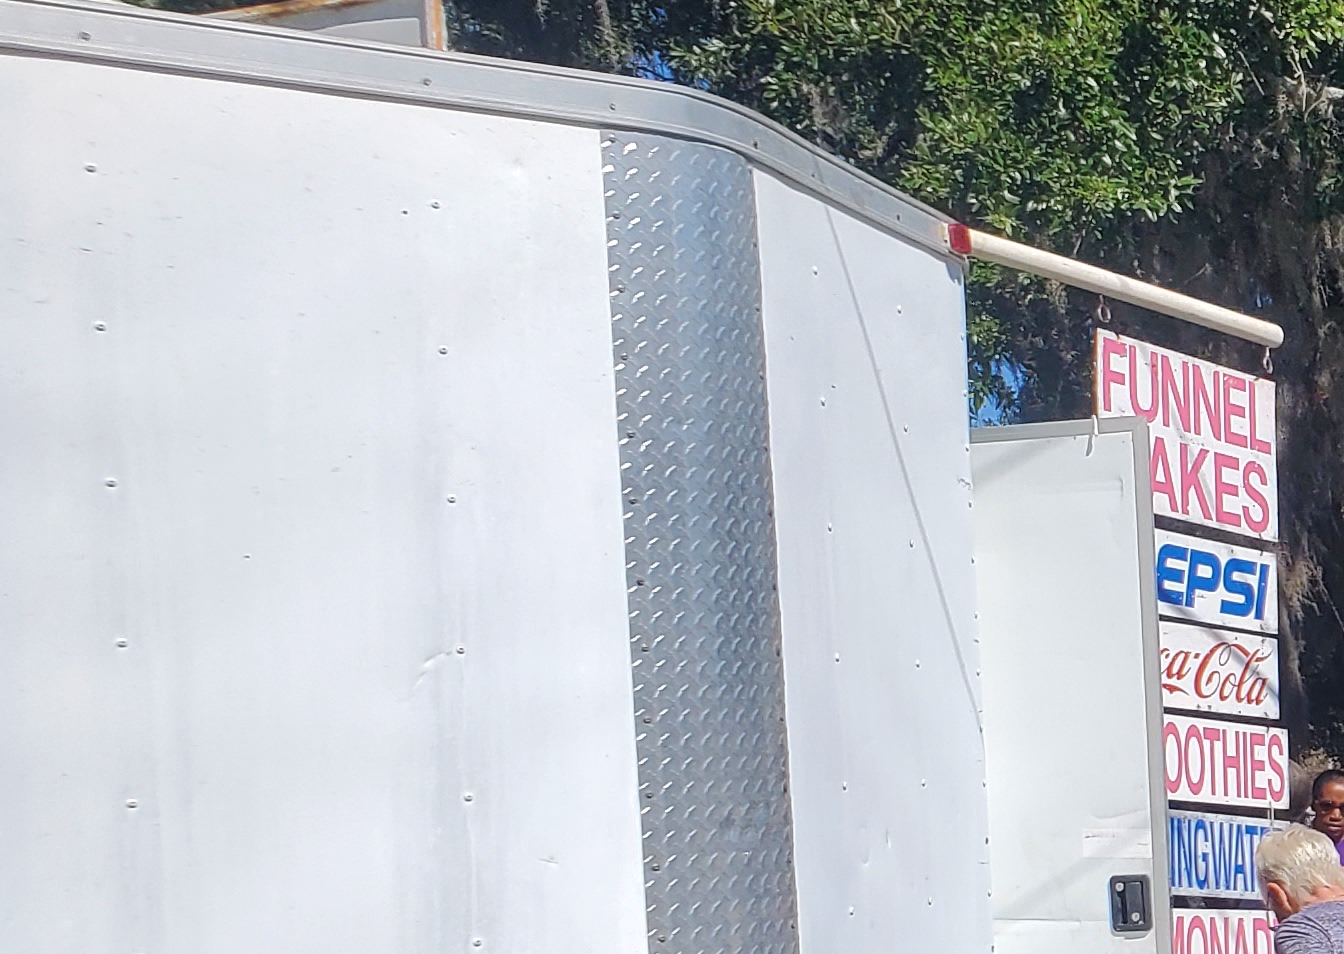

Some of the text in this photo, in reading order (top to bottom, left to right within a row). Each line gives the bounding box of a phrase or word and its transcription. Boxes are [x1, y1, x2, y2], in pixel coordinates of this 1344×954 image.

[1102, 336, 1272, 455] FUNNEL
[1151, 436, 1270, 533] AKES
[1156, 543, 1271, 621] EPSI
[1160, 641, 1274, 706] ca-Cola
[1164, 721, 1285, 802] OOTHIES
[1169, 817, 1284, 892] INGWAT
